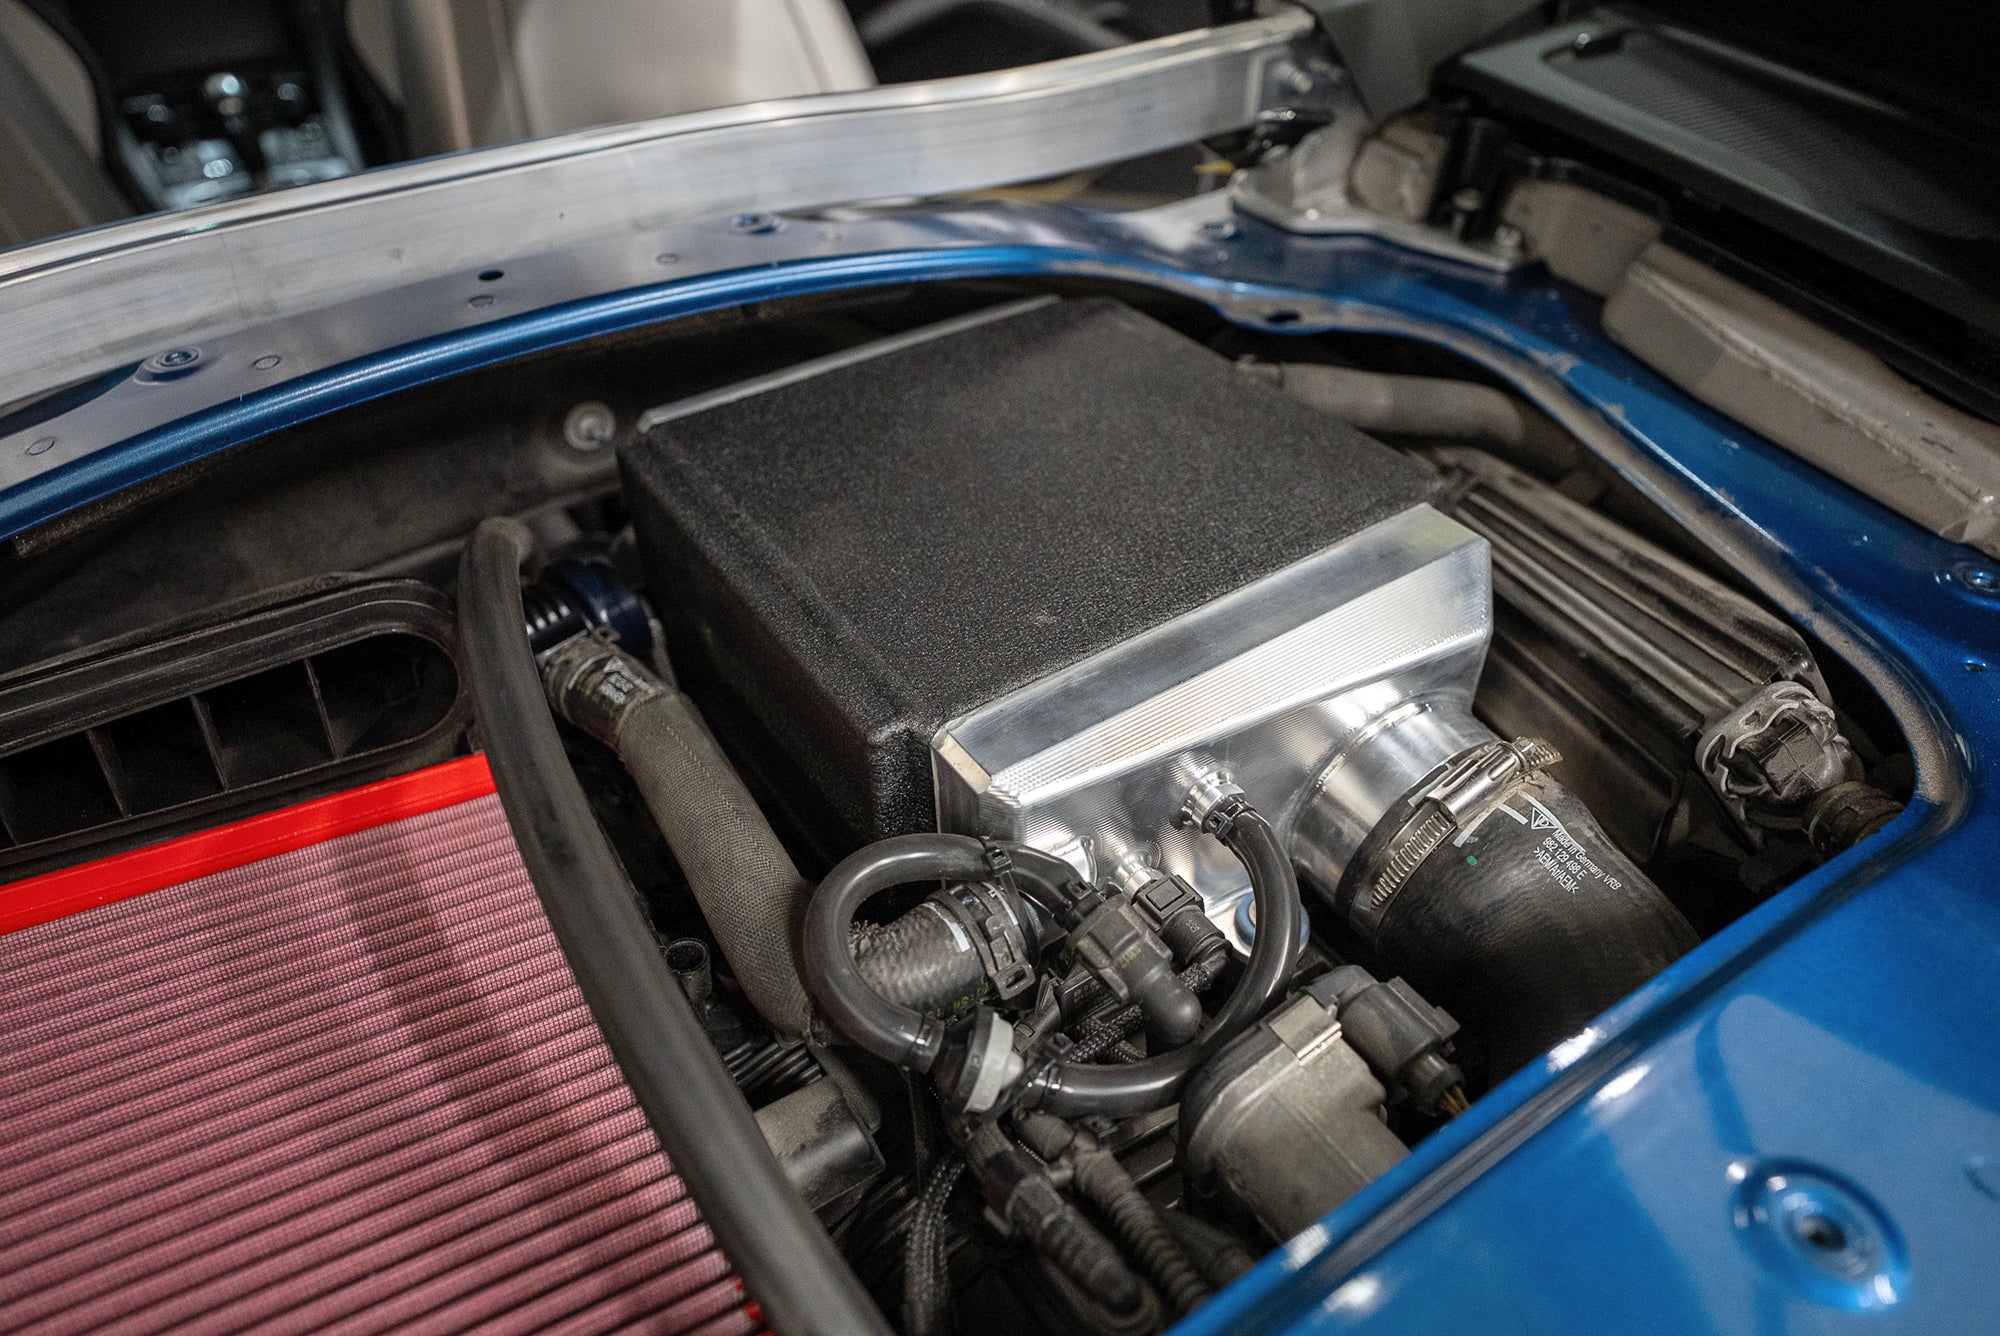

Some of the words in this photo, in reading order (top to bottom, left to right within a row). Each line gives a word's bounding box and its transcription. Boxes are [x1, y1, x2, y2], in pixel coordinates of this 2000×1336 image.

[1542, 837, 1558, 852] 982
[1554, 848, 1569, 863] 129
[1576, 869, 1588, 880] E
[1552, 829, 1571, 848] Made
[1569, 844, 1577, 855] in
[1575, 851, 1605, 879] Germany
